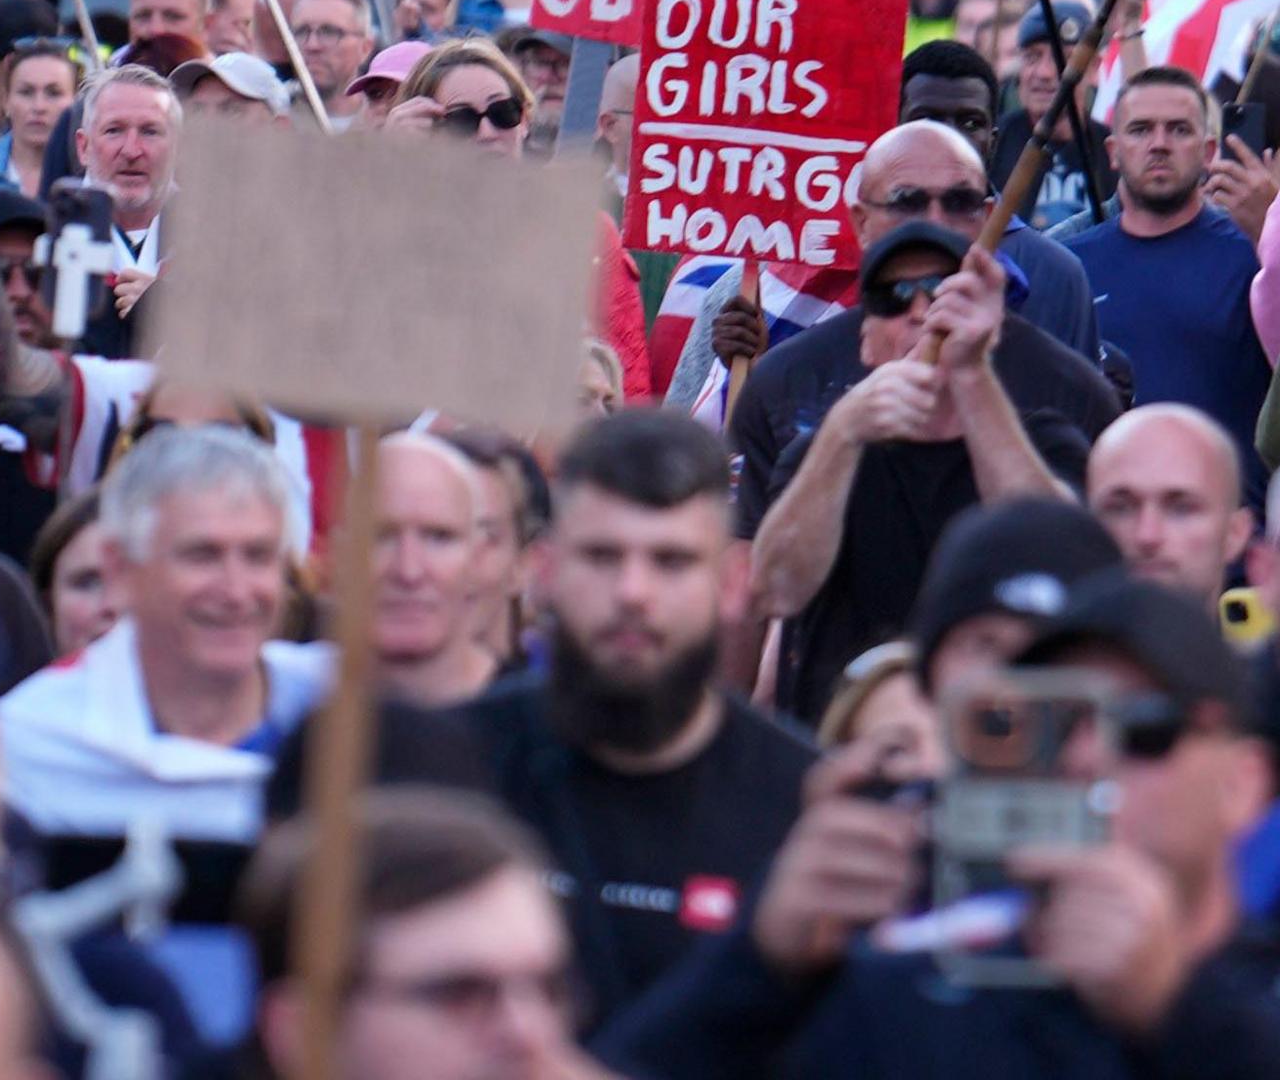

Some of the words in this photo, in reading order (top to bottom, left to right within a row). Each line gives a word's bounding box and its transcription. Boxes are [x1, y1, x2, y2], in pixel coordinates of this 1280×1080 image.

[645, 52, 829, 119] GIRLS
[640, 142, 787, 201] SUTR
[646, 198, 841, 266] HOME
